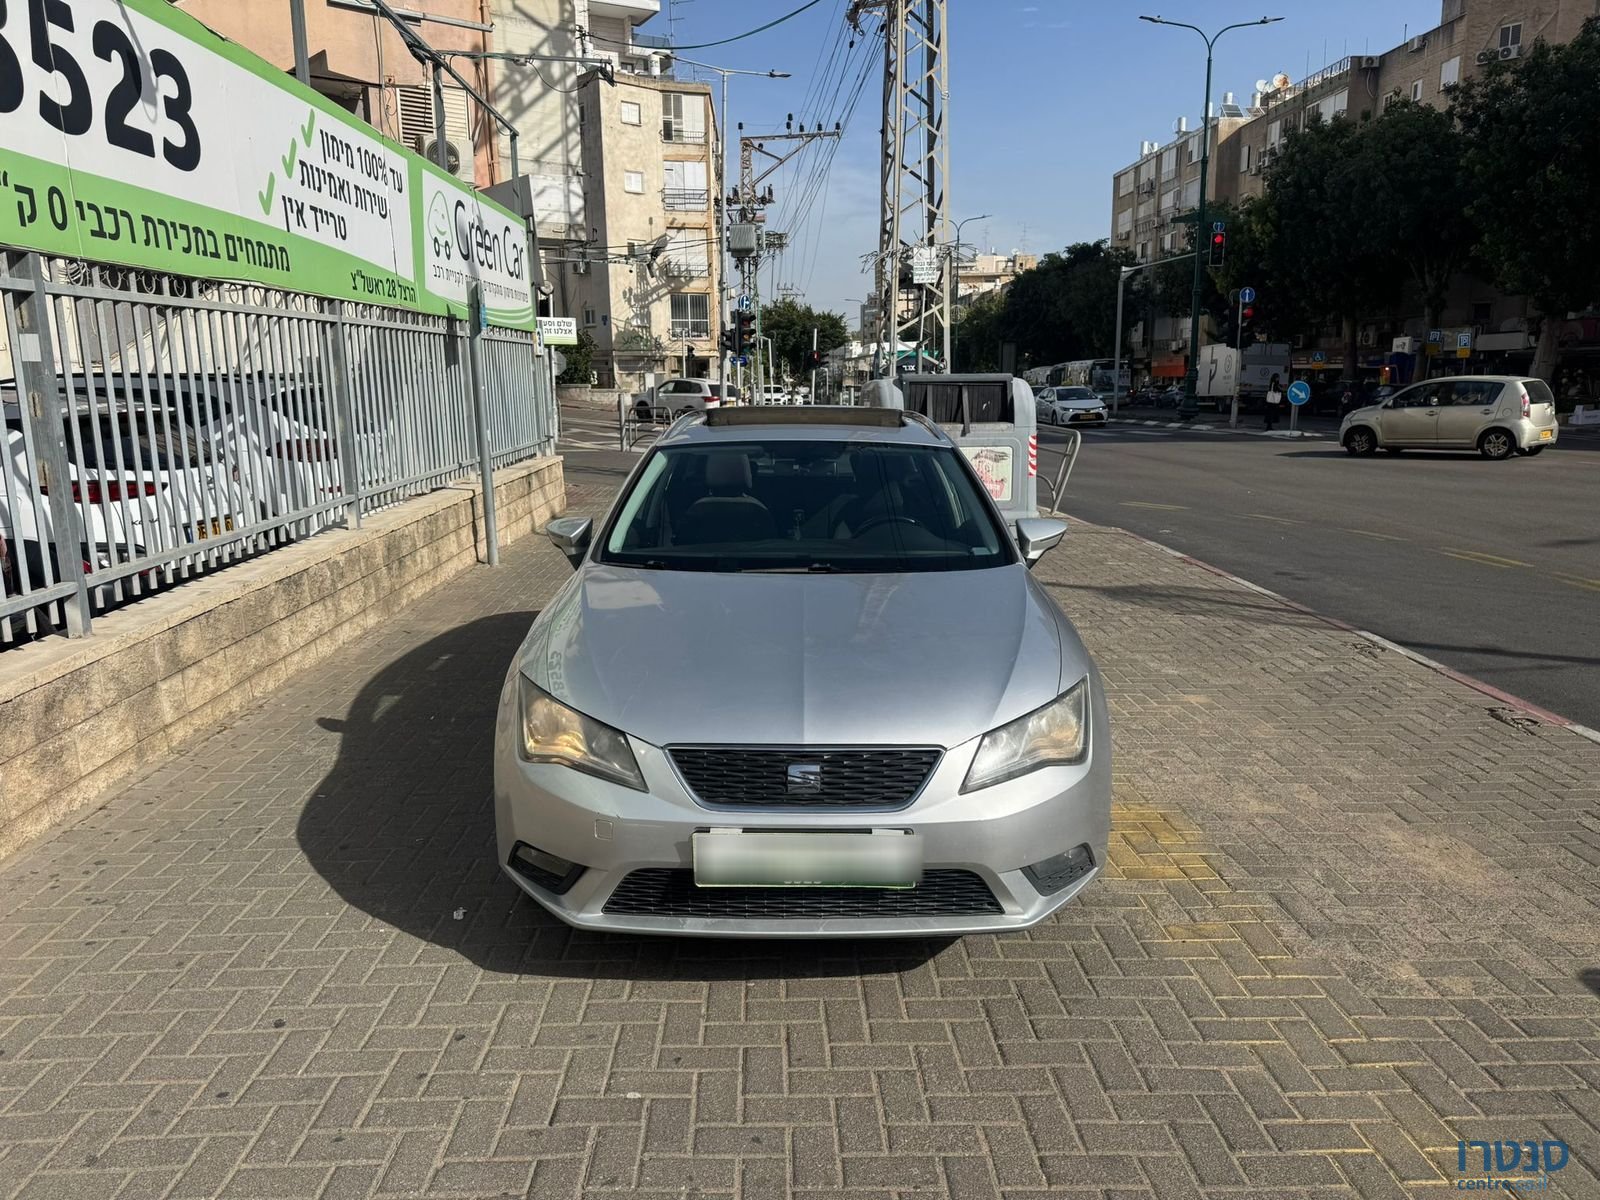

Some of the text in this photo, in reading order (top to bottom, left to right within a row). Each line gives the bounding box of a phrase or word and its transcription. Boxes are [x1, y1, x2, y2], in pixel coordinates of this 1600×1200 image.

[320, 129, 403, 194] עד 100% מימון
[47, 185, 68, 232] 0
[298, 159, 388, 220] שירות ואמינות
[74, 199, 137, 244] רכבי
[141, 214, 221, 259] במכירת
[282, 195, 347, 241] טרייד אין
[454, 199, 524, 281] Green Car
[224, 233, 291, 272] מתמחים
[432, 264, 445, 280] רכב
[350, 269, 417, 303] הרצל 28 ראשל"צ
[557, 319, 573, 327] שלם
